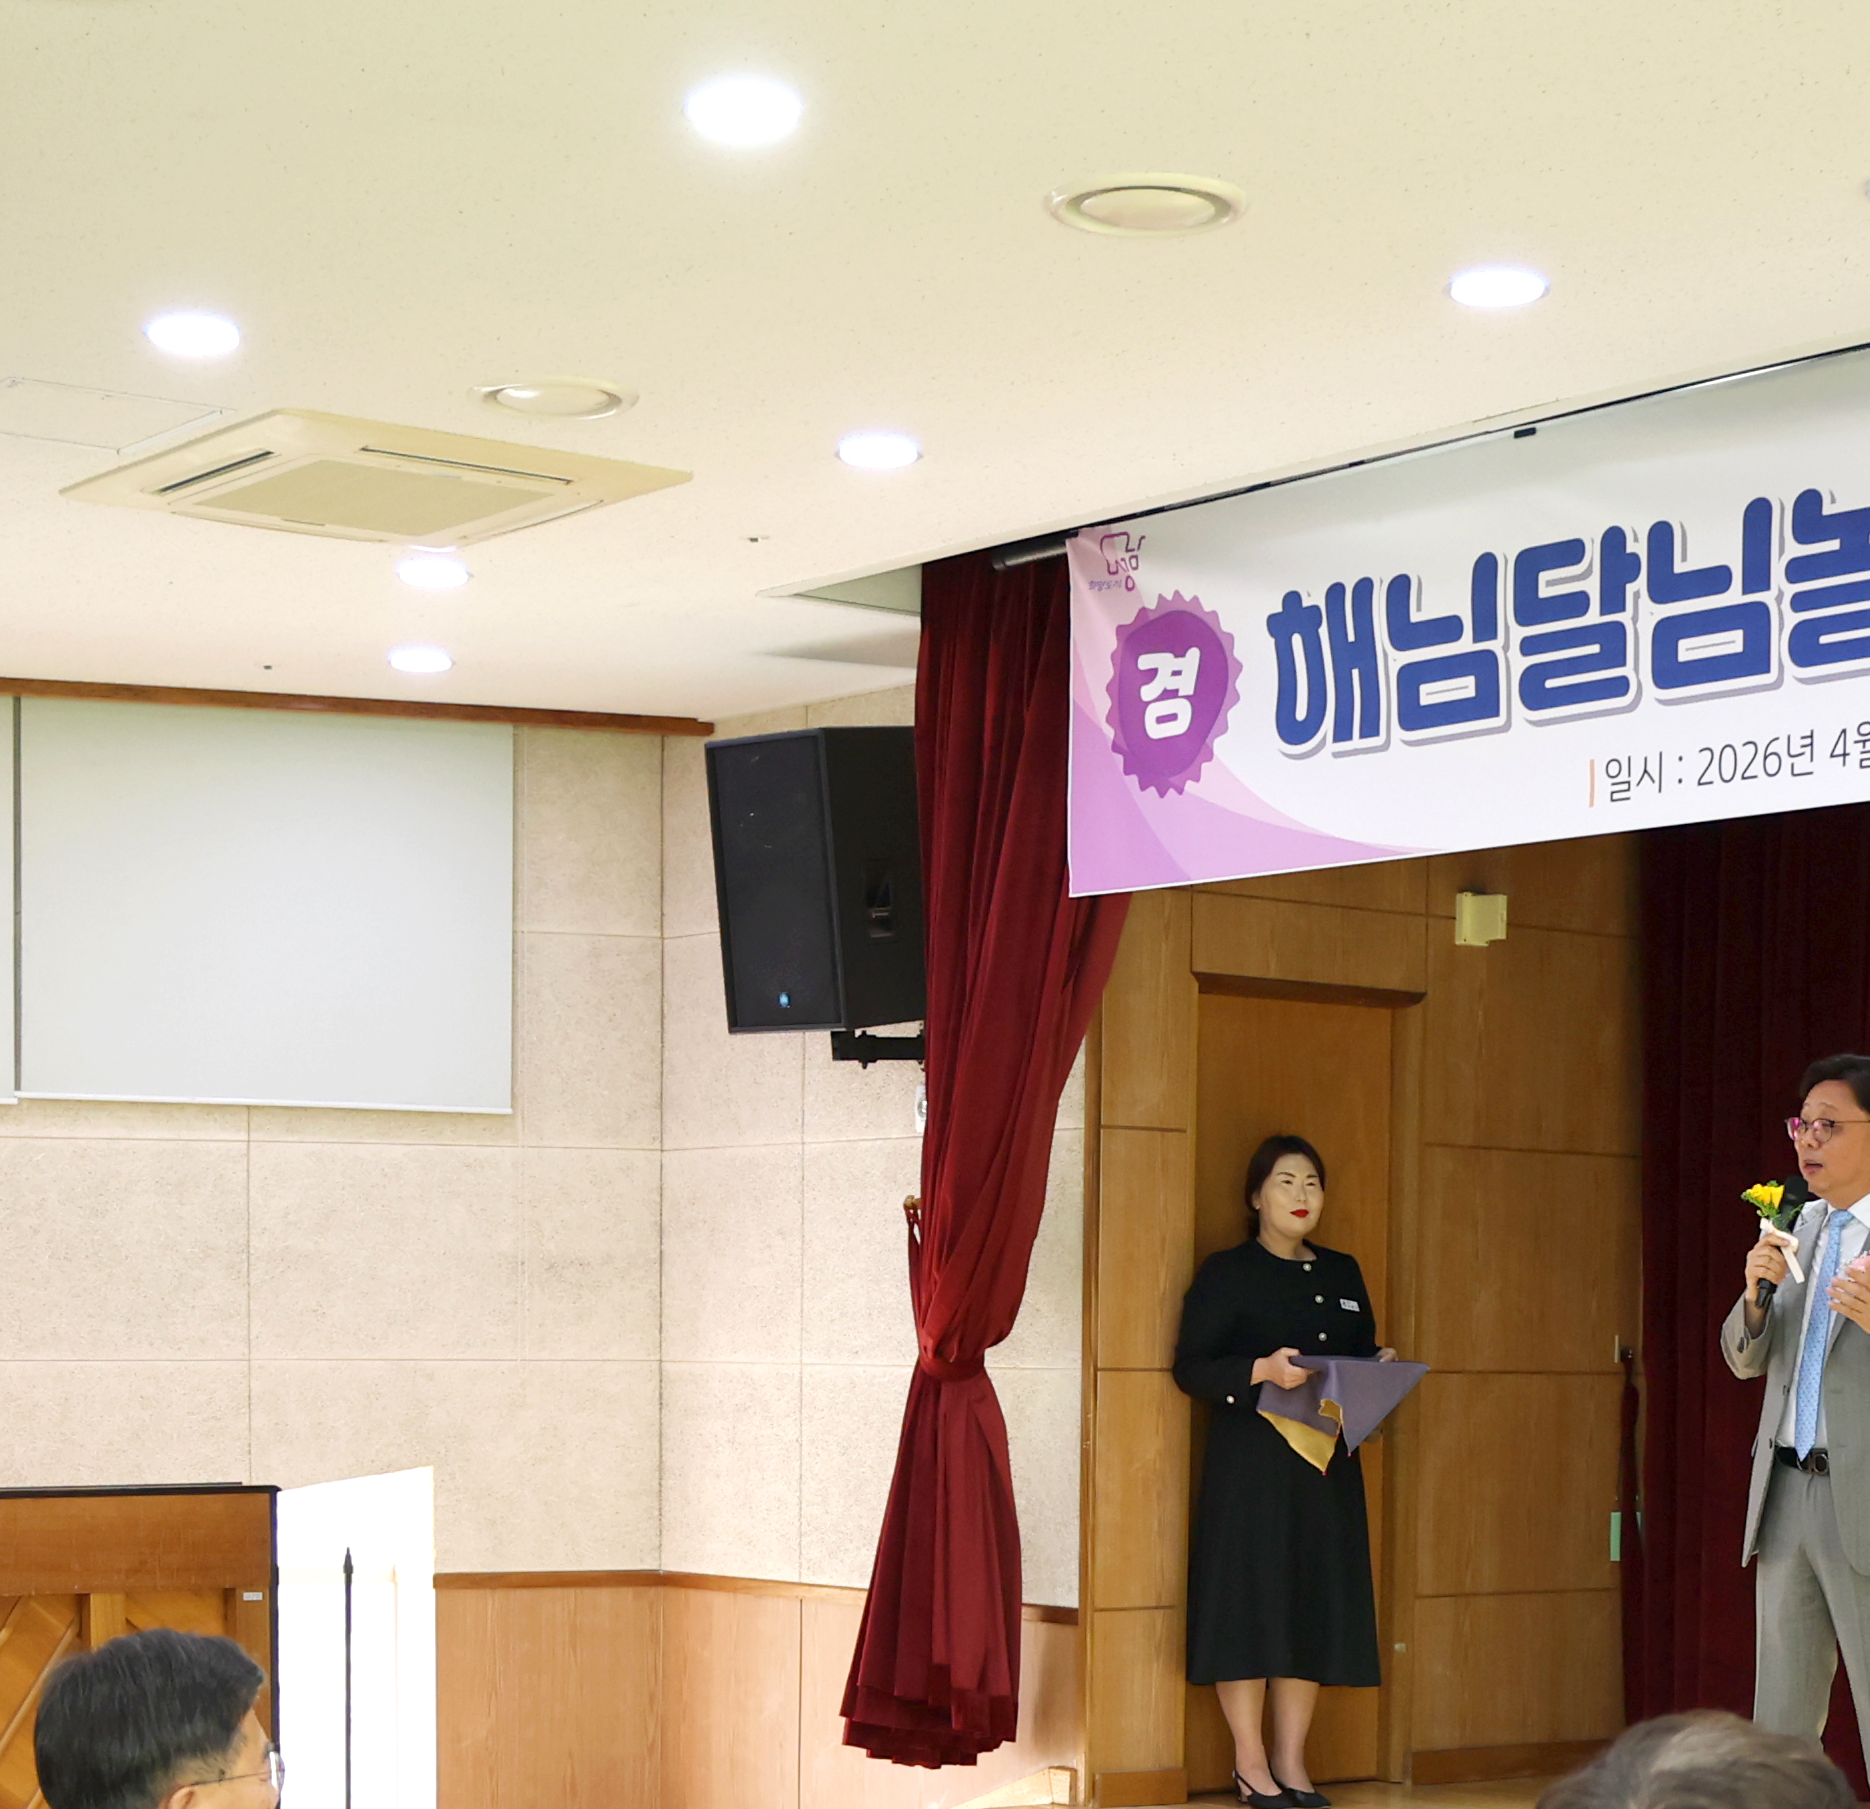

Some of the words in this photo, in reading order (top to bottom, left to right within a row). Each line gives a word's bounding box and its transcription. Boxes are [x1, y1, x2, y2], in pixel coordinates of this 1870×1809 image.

[1136, 646, 1201, 741] 경
[1603, 750, 1665, 803] 일시
[1695, 728, 1816, 788] 2026년
